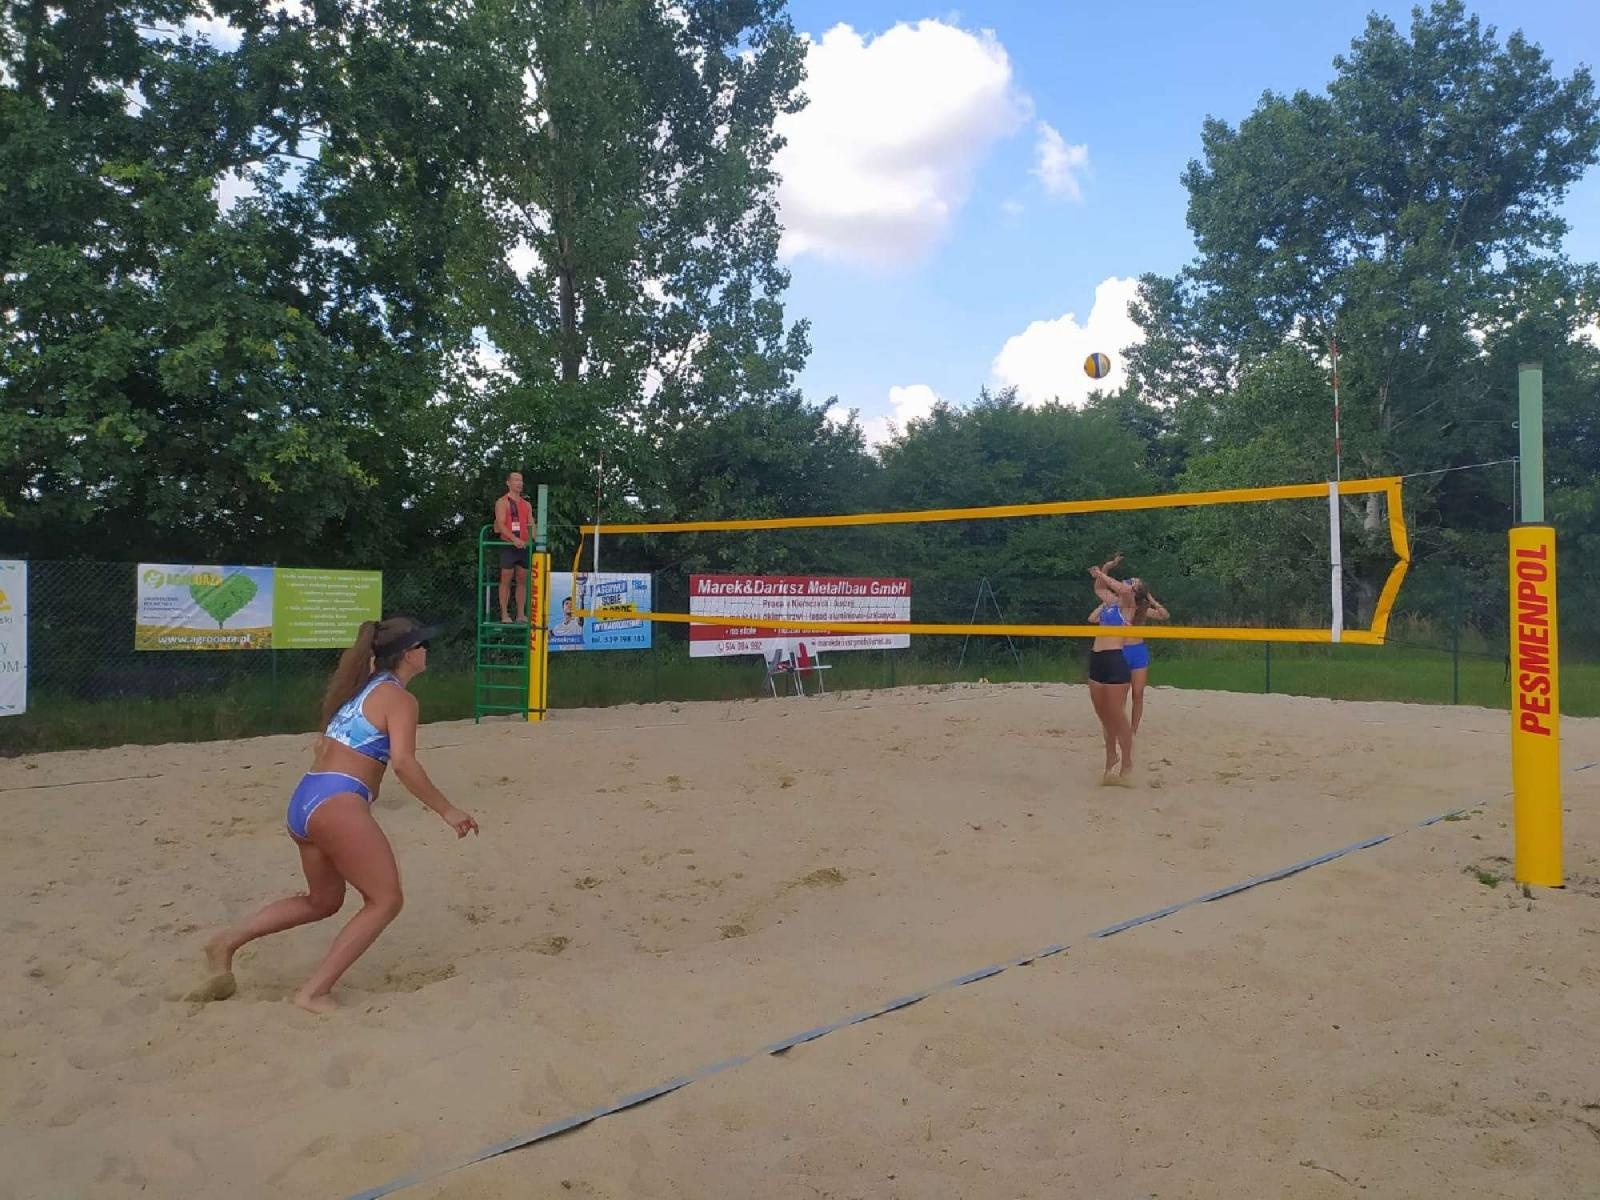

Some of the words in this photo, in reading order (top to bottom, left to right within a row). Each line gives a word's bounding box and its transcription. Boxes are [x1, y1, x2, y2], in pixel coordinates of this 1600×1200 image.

[698, 580, 804, 594] Marek&Dariusz
[808, 581, 867, 594] Metallbau
[870, 581, 907, 594] GmbH
[1516, 545, 1550, 736] PESMENPOL
